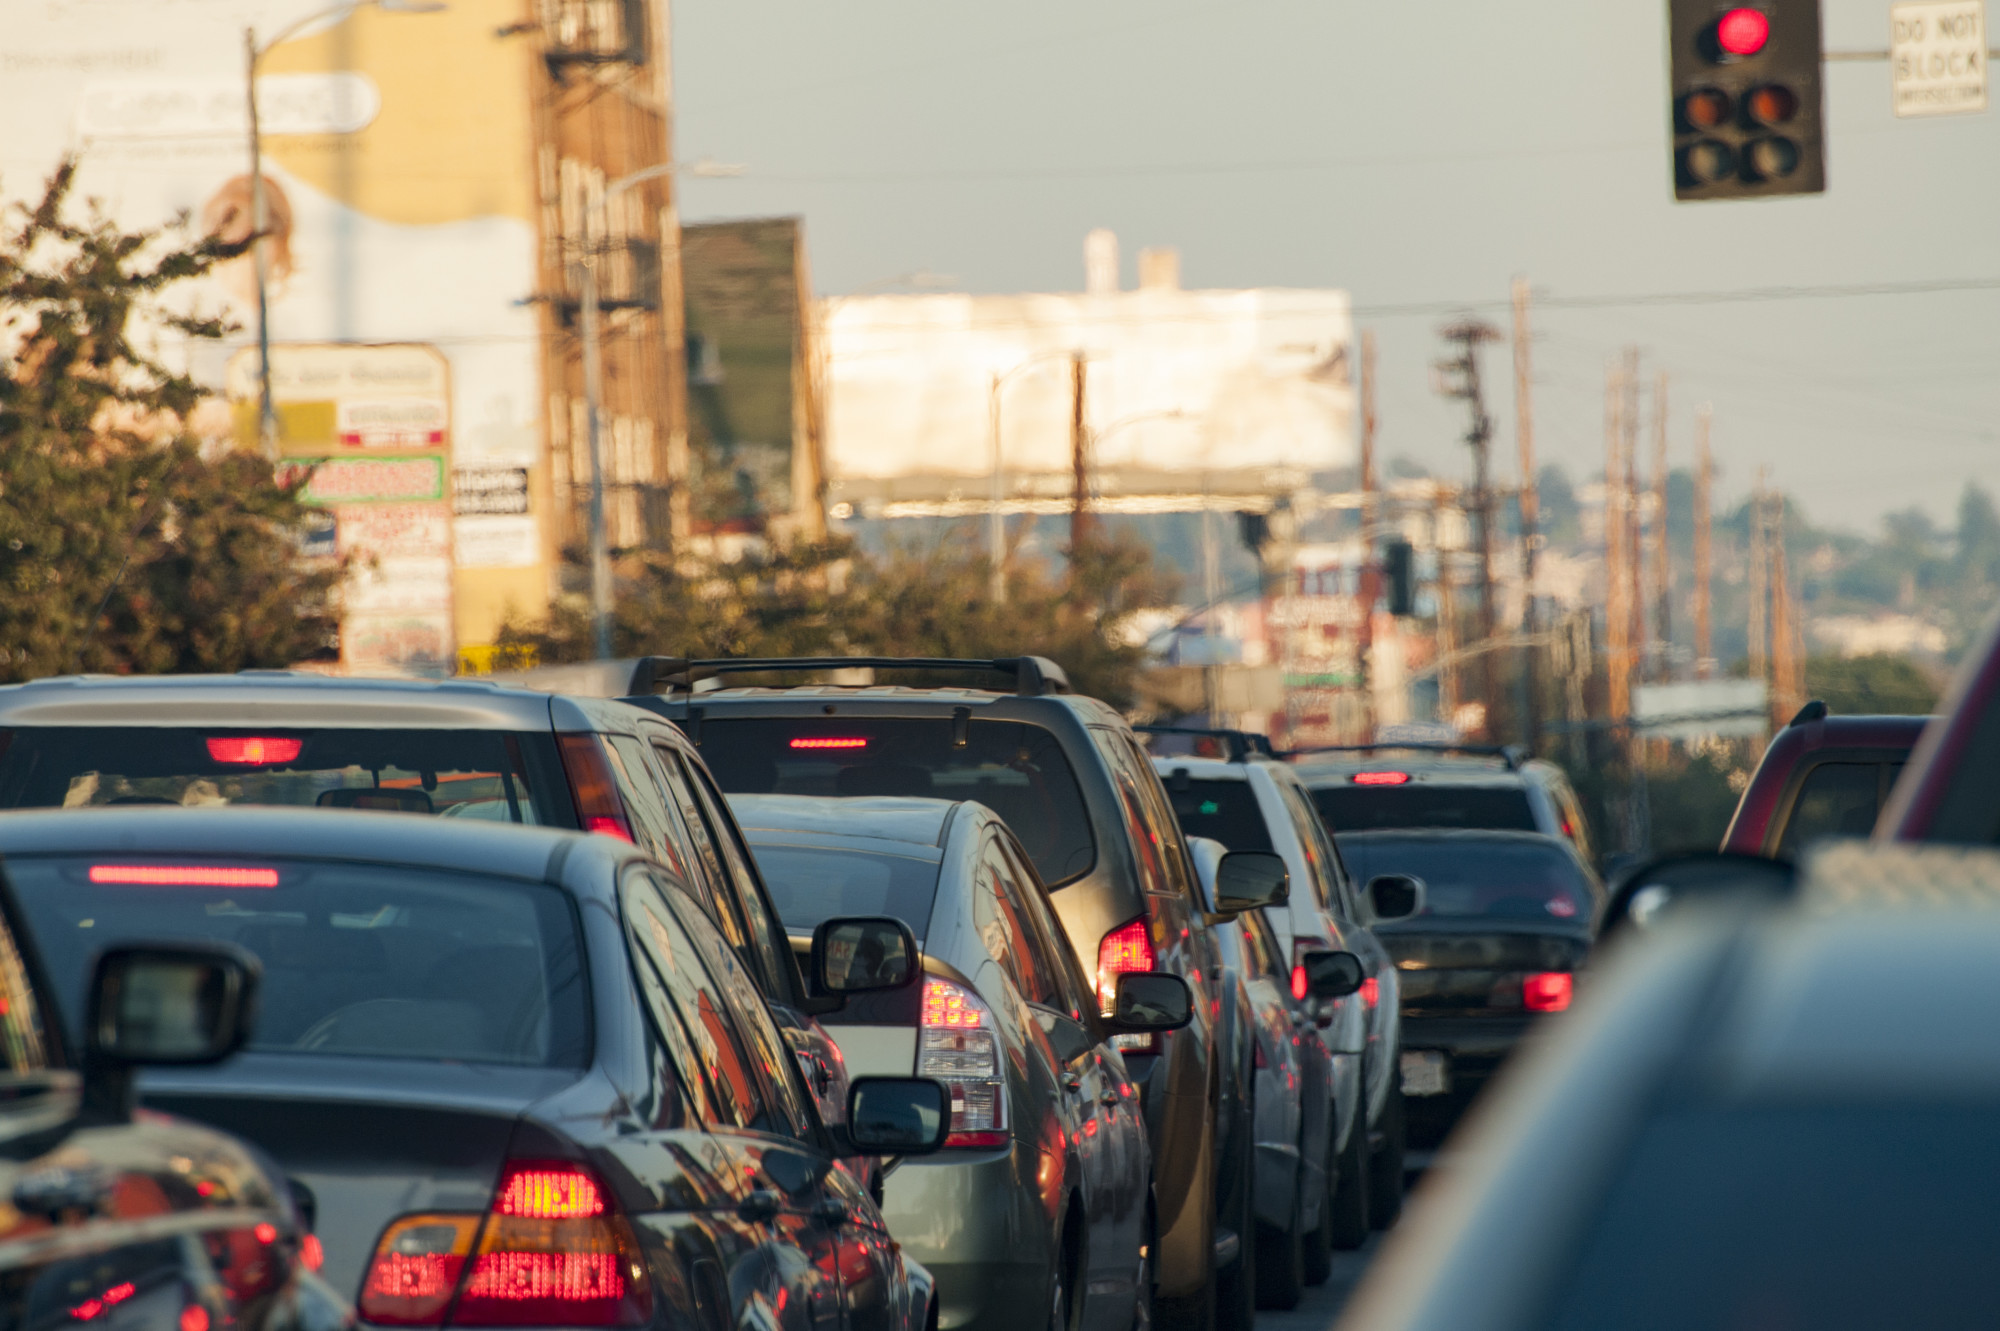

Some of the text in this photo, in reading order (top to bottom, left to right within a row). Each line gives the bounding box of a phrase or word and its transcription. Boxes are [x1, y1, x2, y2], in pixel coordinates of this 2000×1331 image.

[1894, 14, 1977, 43] DO NOT
[1897, 50, 1978, 80] BLOCK
